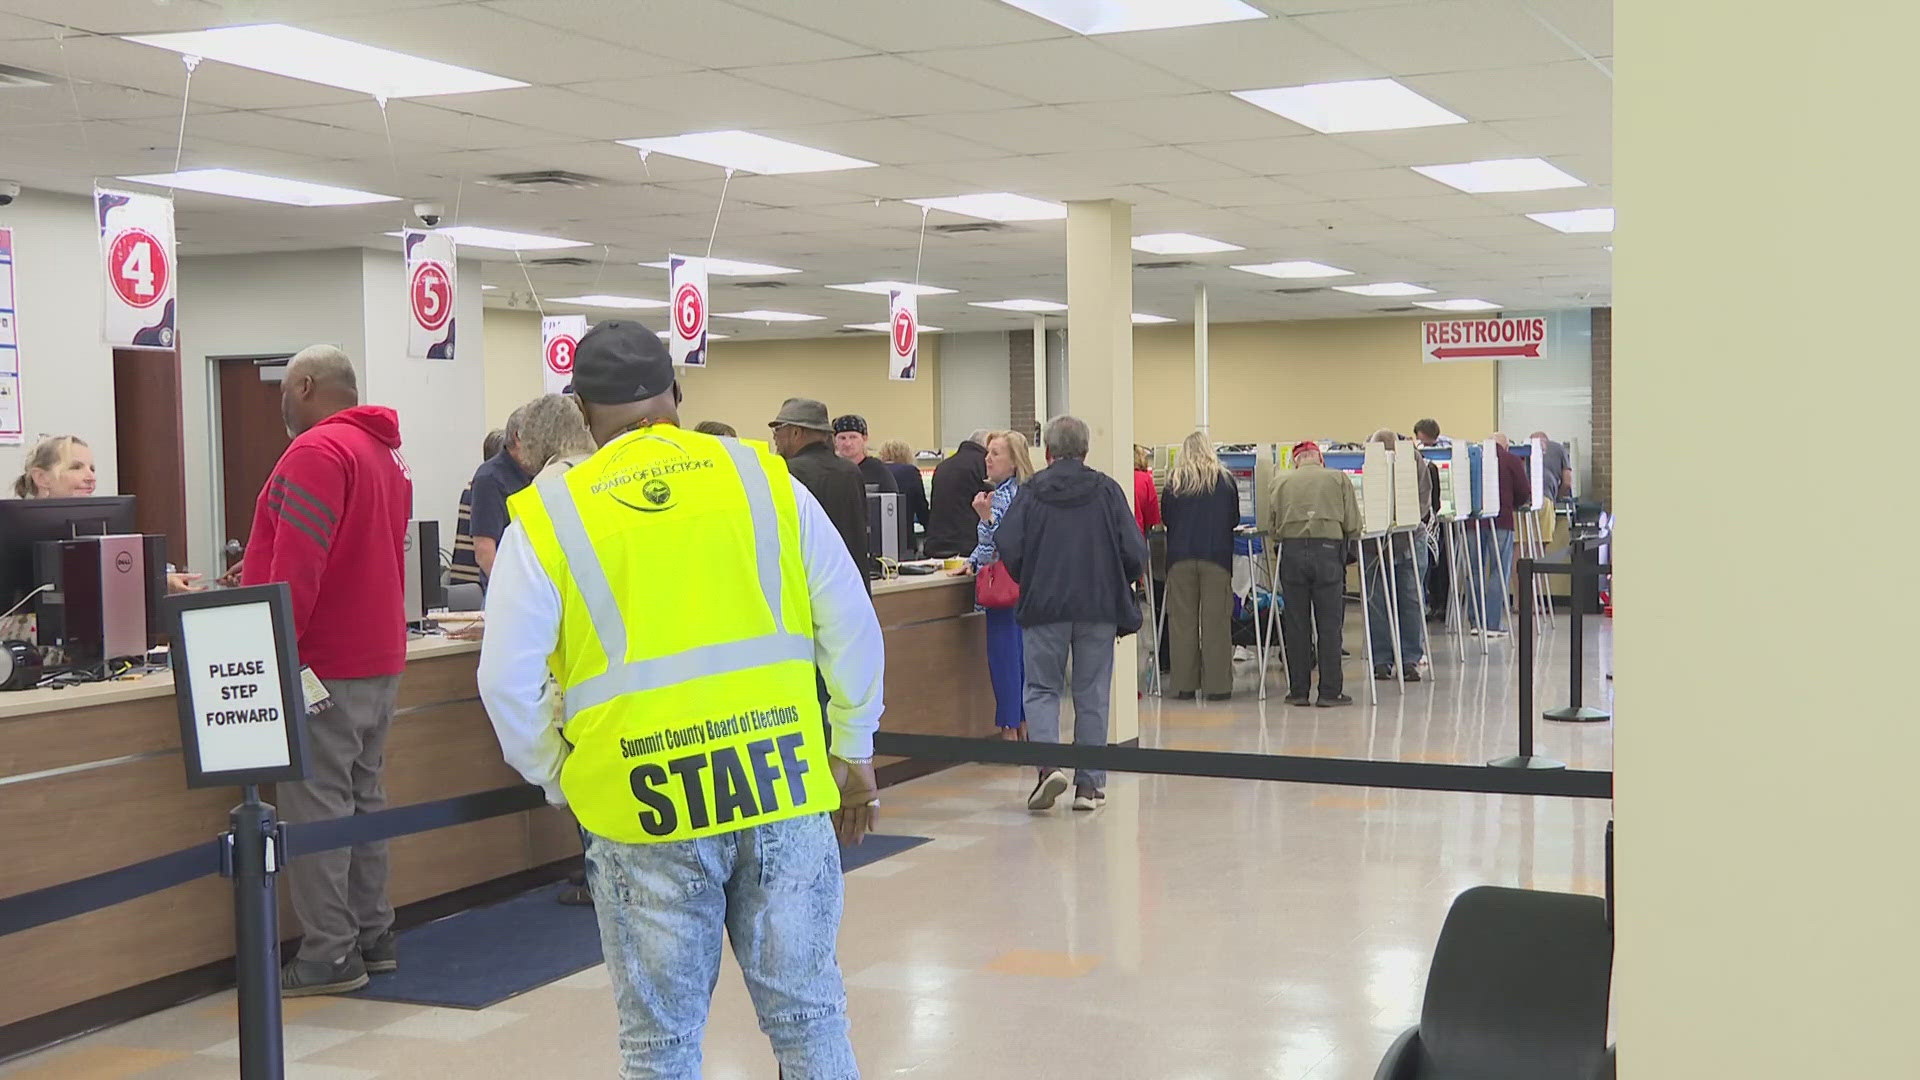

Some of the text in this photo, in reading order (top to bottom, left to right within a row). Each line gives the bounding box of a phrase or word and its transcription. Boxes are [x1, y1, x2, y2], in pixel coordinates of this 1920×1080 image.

[121, 241, 155, 297] 4
[423, 276, 440, 316] 5
[683, 295, 696, 329] 6
[898, 318, 909, 347] 7
[1426, 318, 1544, 345] RESTROOMS
[555, 342, 571, 368] 8
[590, 475, 631, 494] BOARD
[633, 469, 650, 482] OF
[651, 458, 713, 476] ELECTIONS
[209, 660, 265, 679] PLEASE
[221, 684, 258, 700] STEP
[206, 707, 279, 727] FORWARD
[620, 705, 799, 759] Summit County Board of Elections
[629, 731, 810, 836] STAFF
